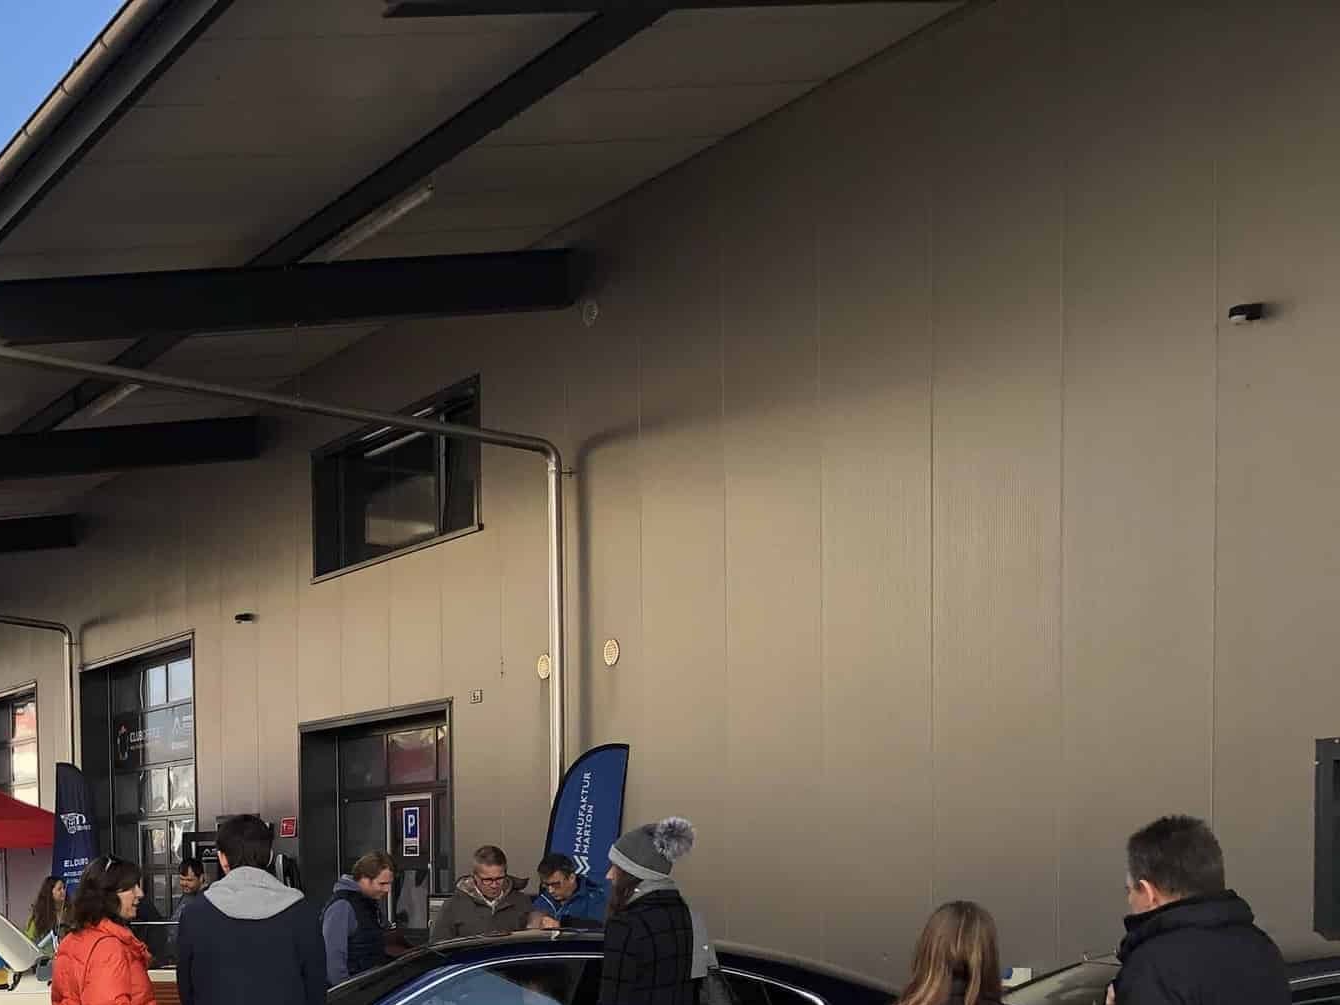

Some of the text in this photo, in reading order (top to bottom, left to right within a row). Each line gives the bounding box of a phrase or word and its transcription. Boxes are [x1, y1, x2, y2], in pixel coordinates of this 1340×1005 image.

[407, 813, 417, 836] P
[573, 771, 592, 853] MANUFAKTUR
[582, 803, 595, 855] MARTON
